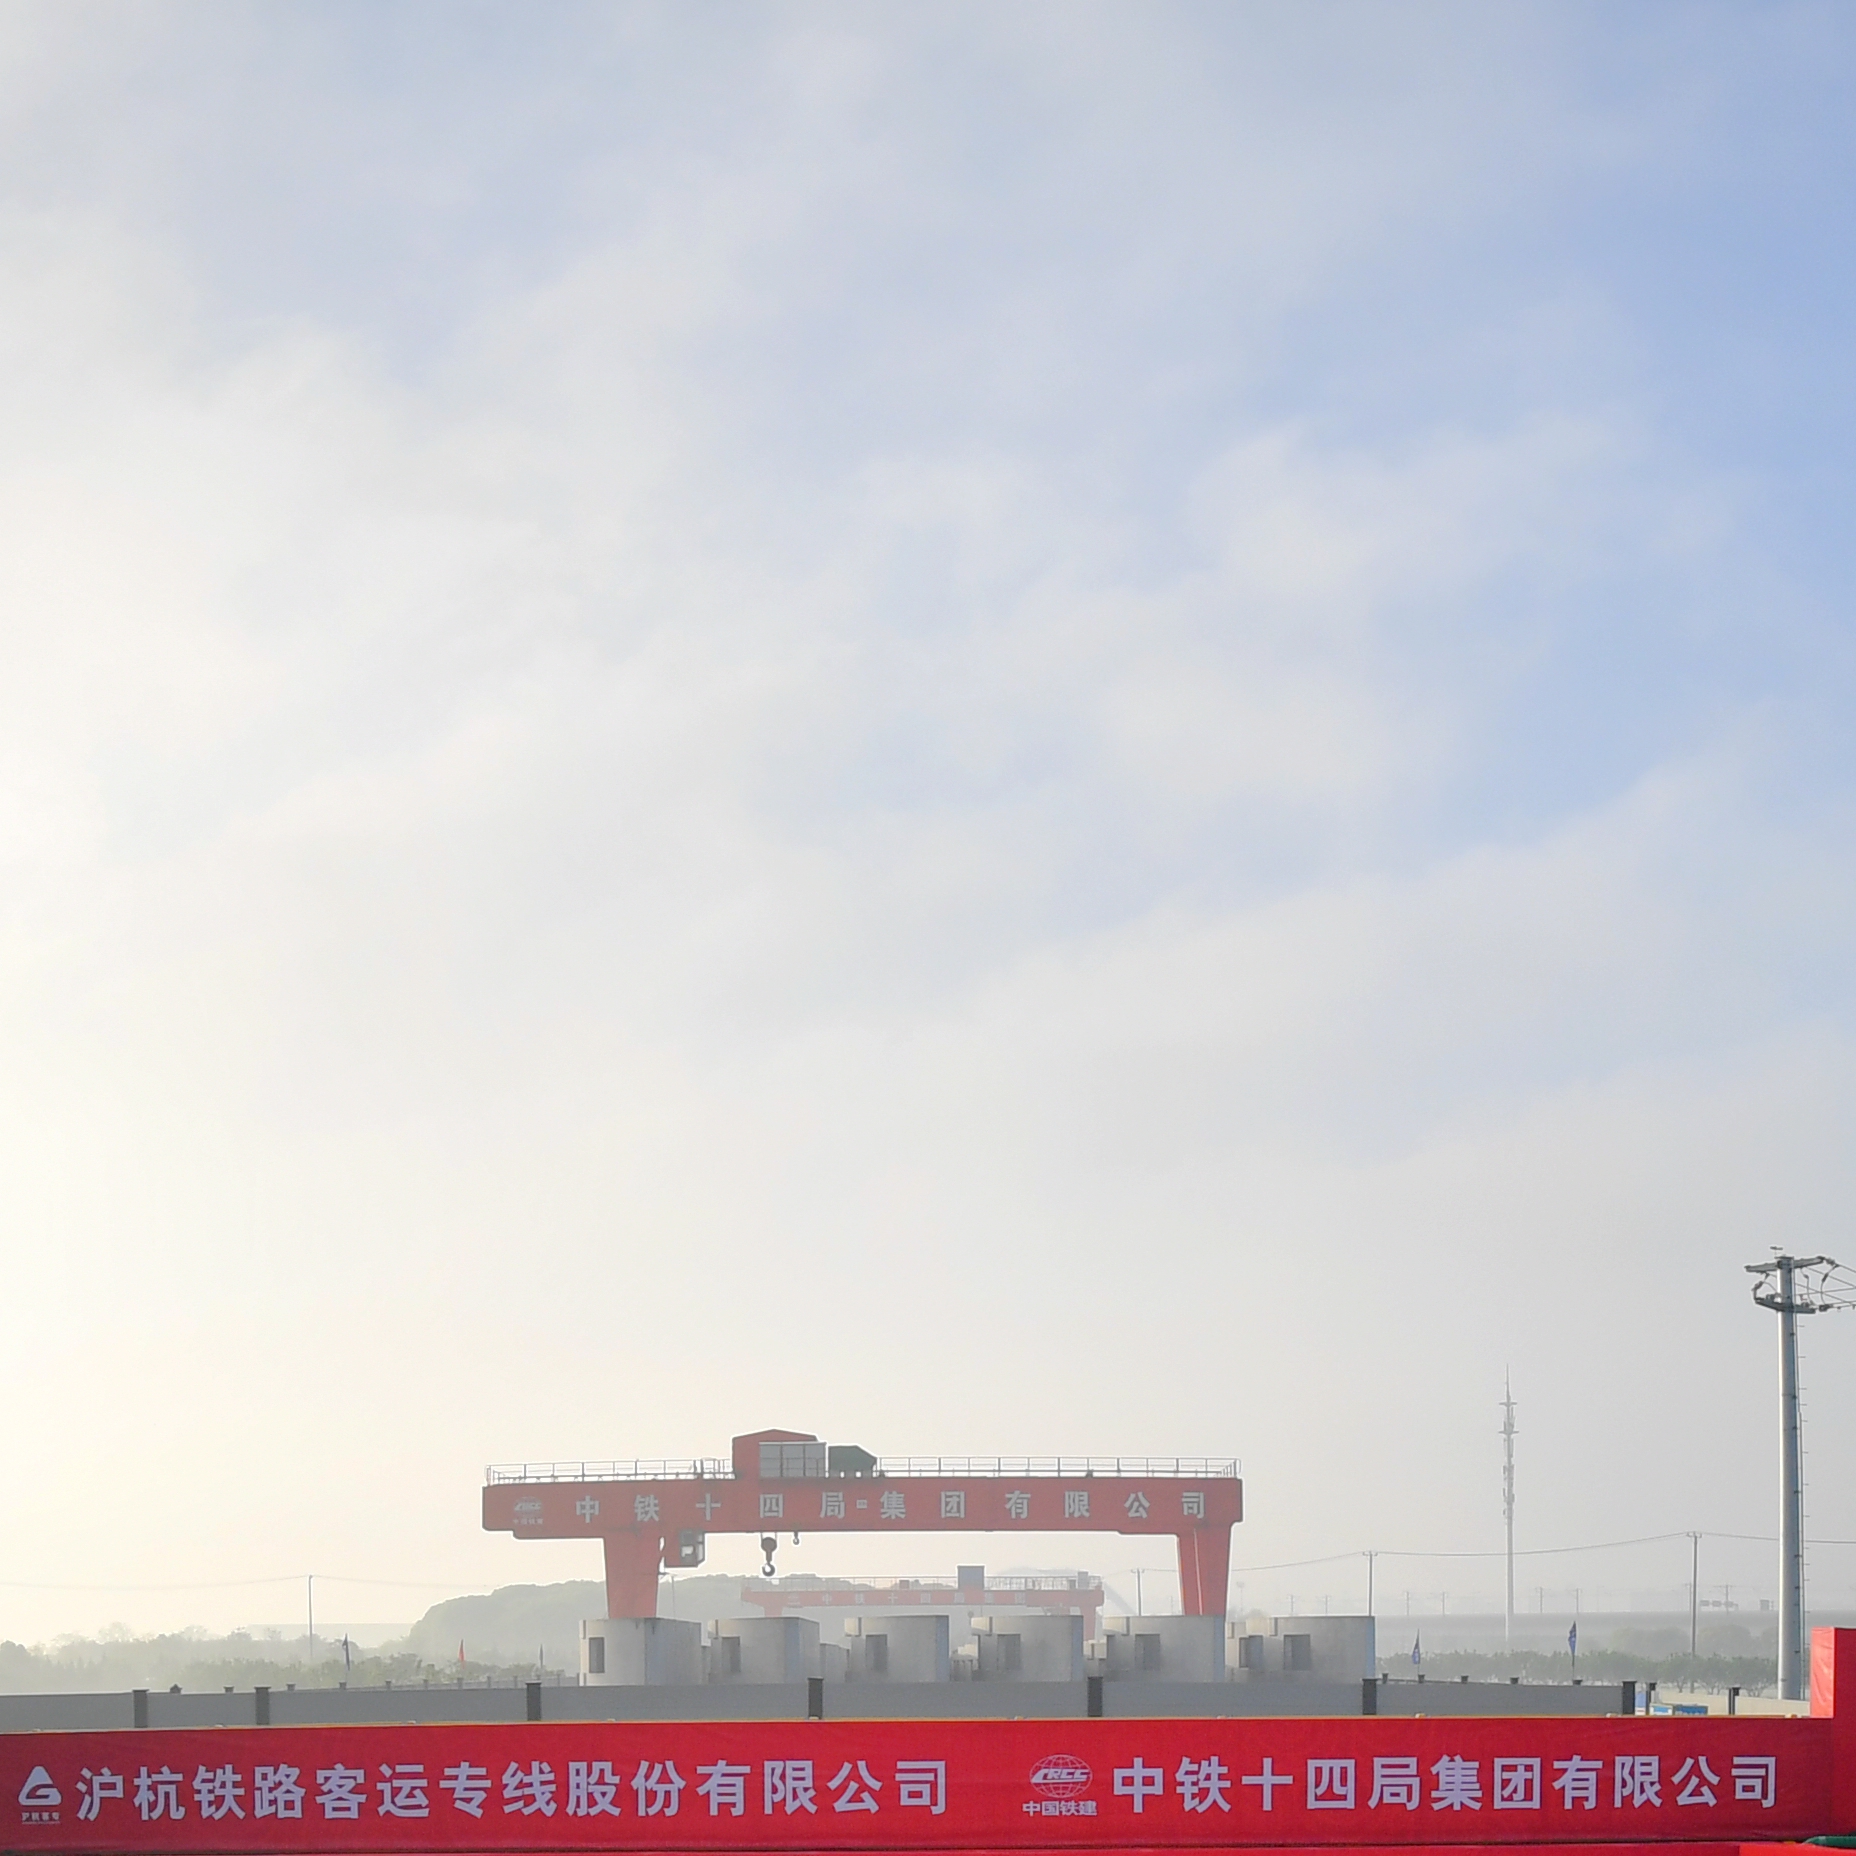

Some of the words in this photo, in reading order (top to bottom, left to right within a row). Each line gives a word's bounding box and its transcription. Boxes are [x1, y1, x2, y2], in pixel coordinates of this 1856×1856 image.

[575, 1490, 1207, 1524] 中铁十四局集团有限公司
[76, 1759, 947, 1822] 沪杭铁路客运专线股份有限公司
[1113, 1754, 1778, 1814] 中铁十四局集团有限公司
[1022, 1800, 1097, 1817] 中国铁建
